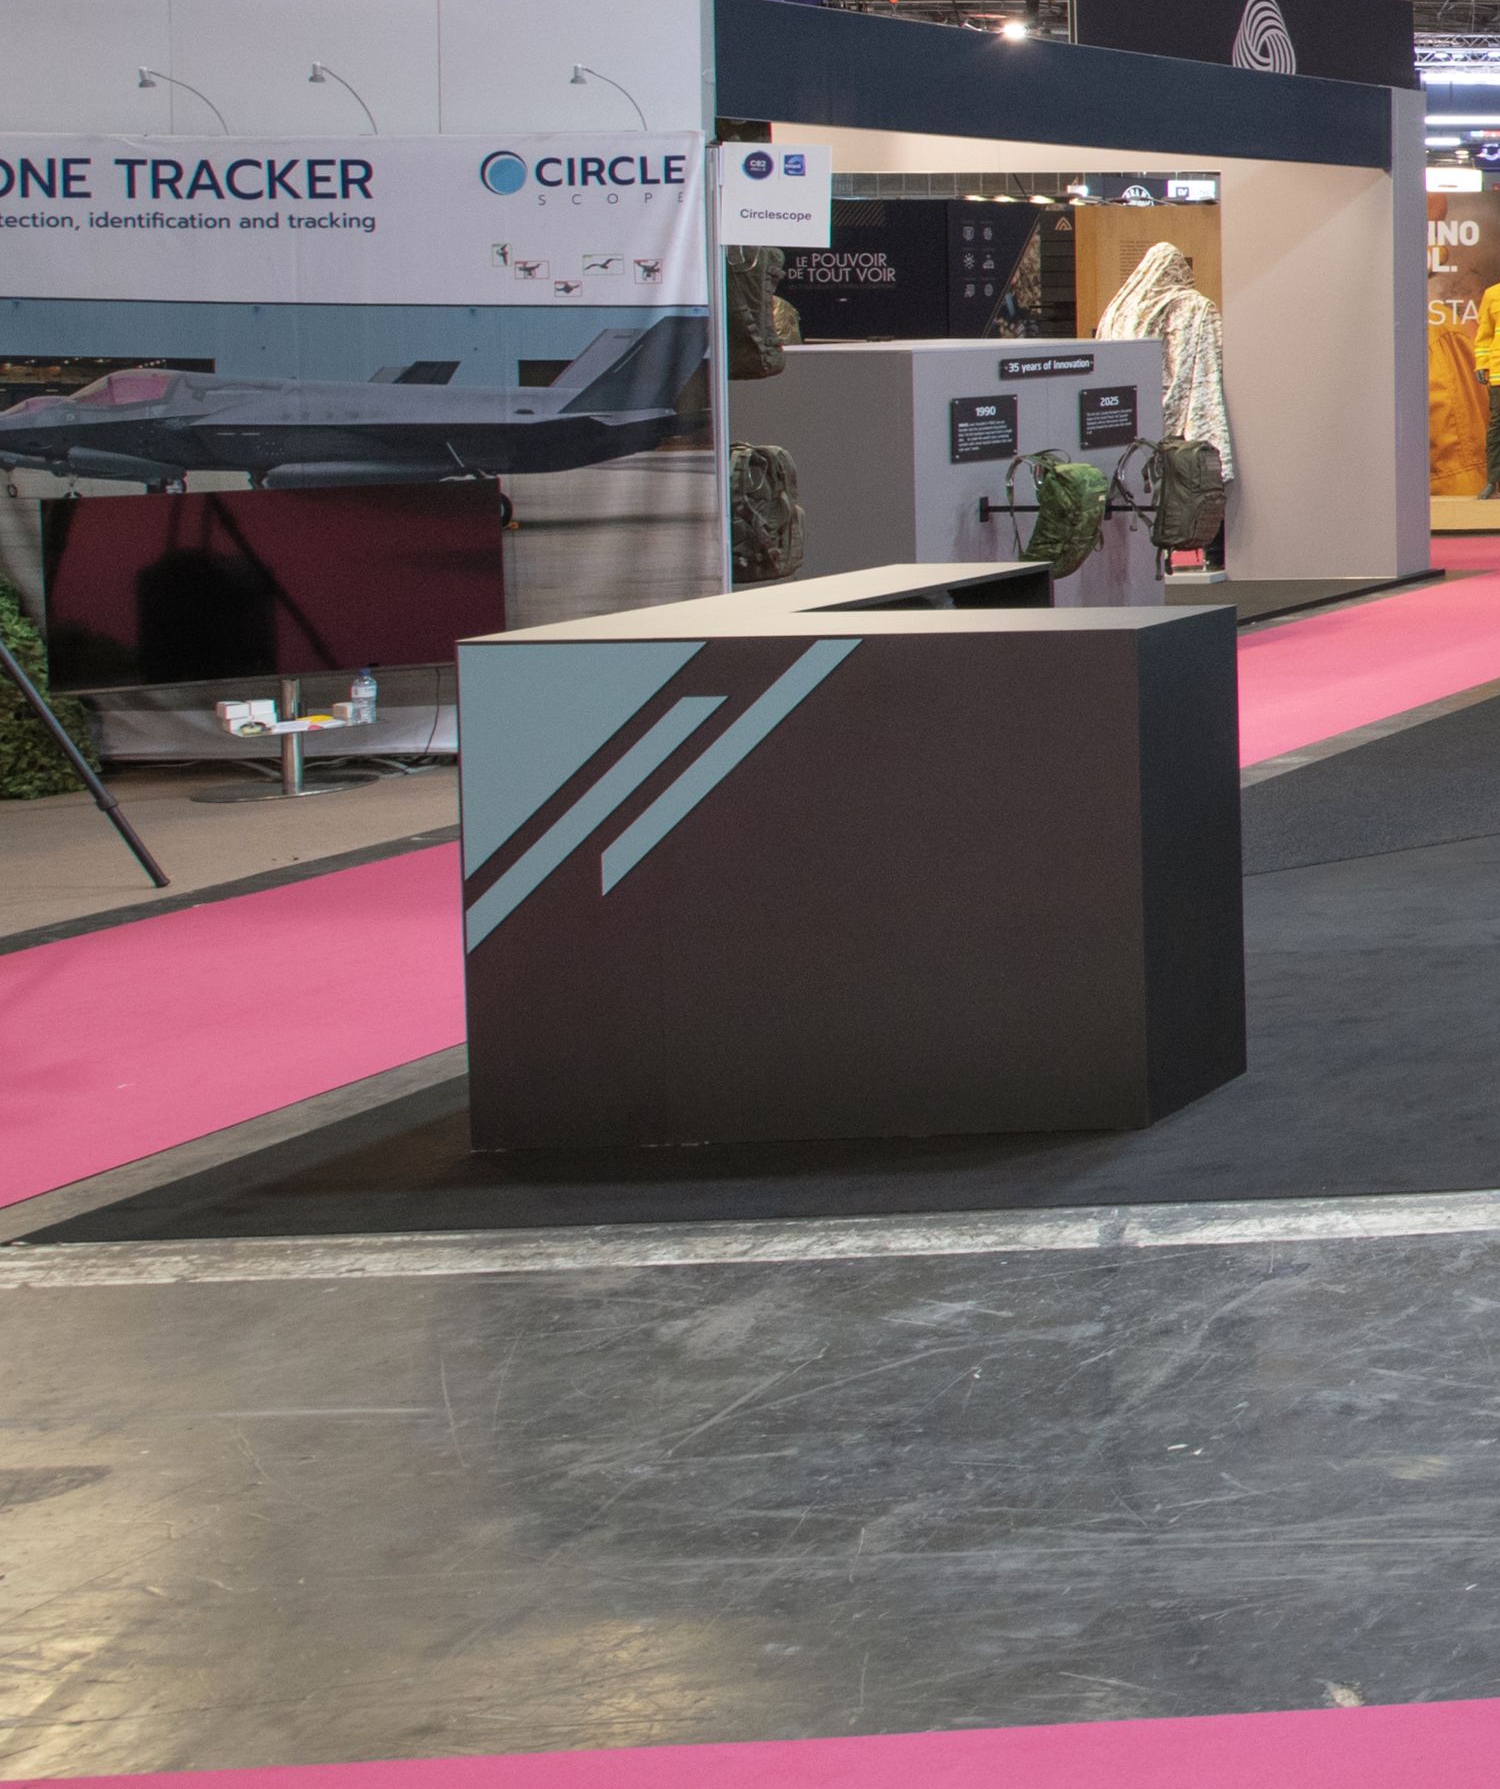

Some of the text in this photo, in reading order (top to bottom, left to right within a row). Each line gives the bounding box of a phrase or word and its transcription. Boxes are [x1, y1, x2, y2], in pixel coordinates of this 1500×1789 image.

[535, 155, 686, 187] CIRCLE
[114, 158, 374, 200] TRACKER
[89, 211, 231, 230] identification
[239, 211, 280, 229] and
[288, 212, 376, 233] tracking
[740, 209, 812, 222] Circlescope
[796, 253, 887, 267] LE POUVOIR
[788, 267, 896, 282] DE TOUT VOIR
[1008, 363, 1020, 373] 35
[1022, 363, 1041, 374] years
[1043, 360, 1052, 370] of
[1099, 395, 1119, 406] 2025
[975, 406, 996, 417] 1990
